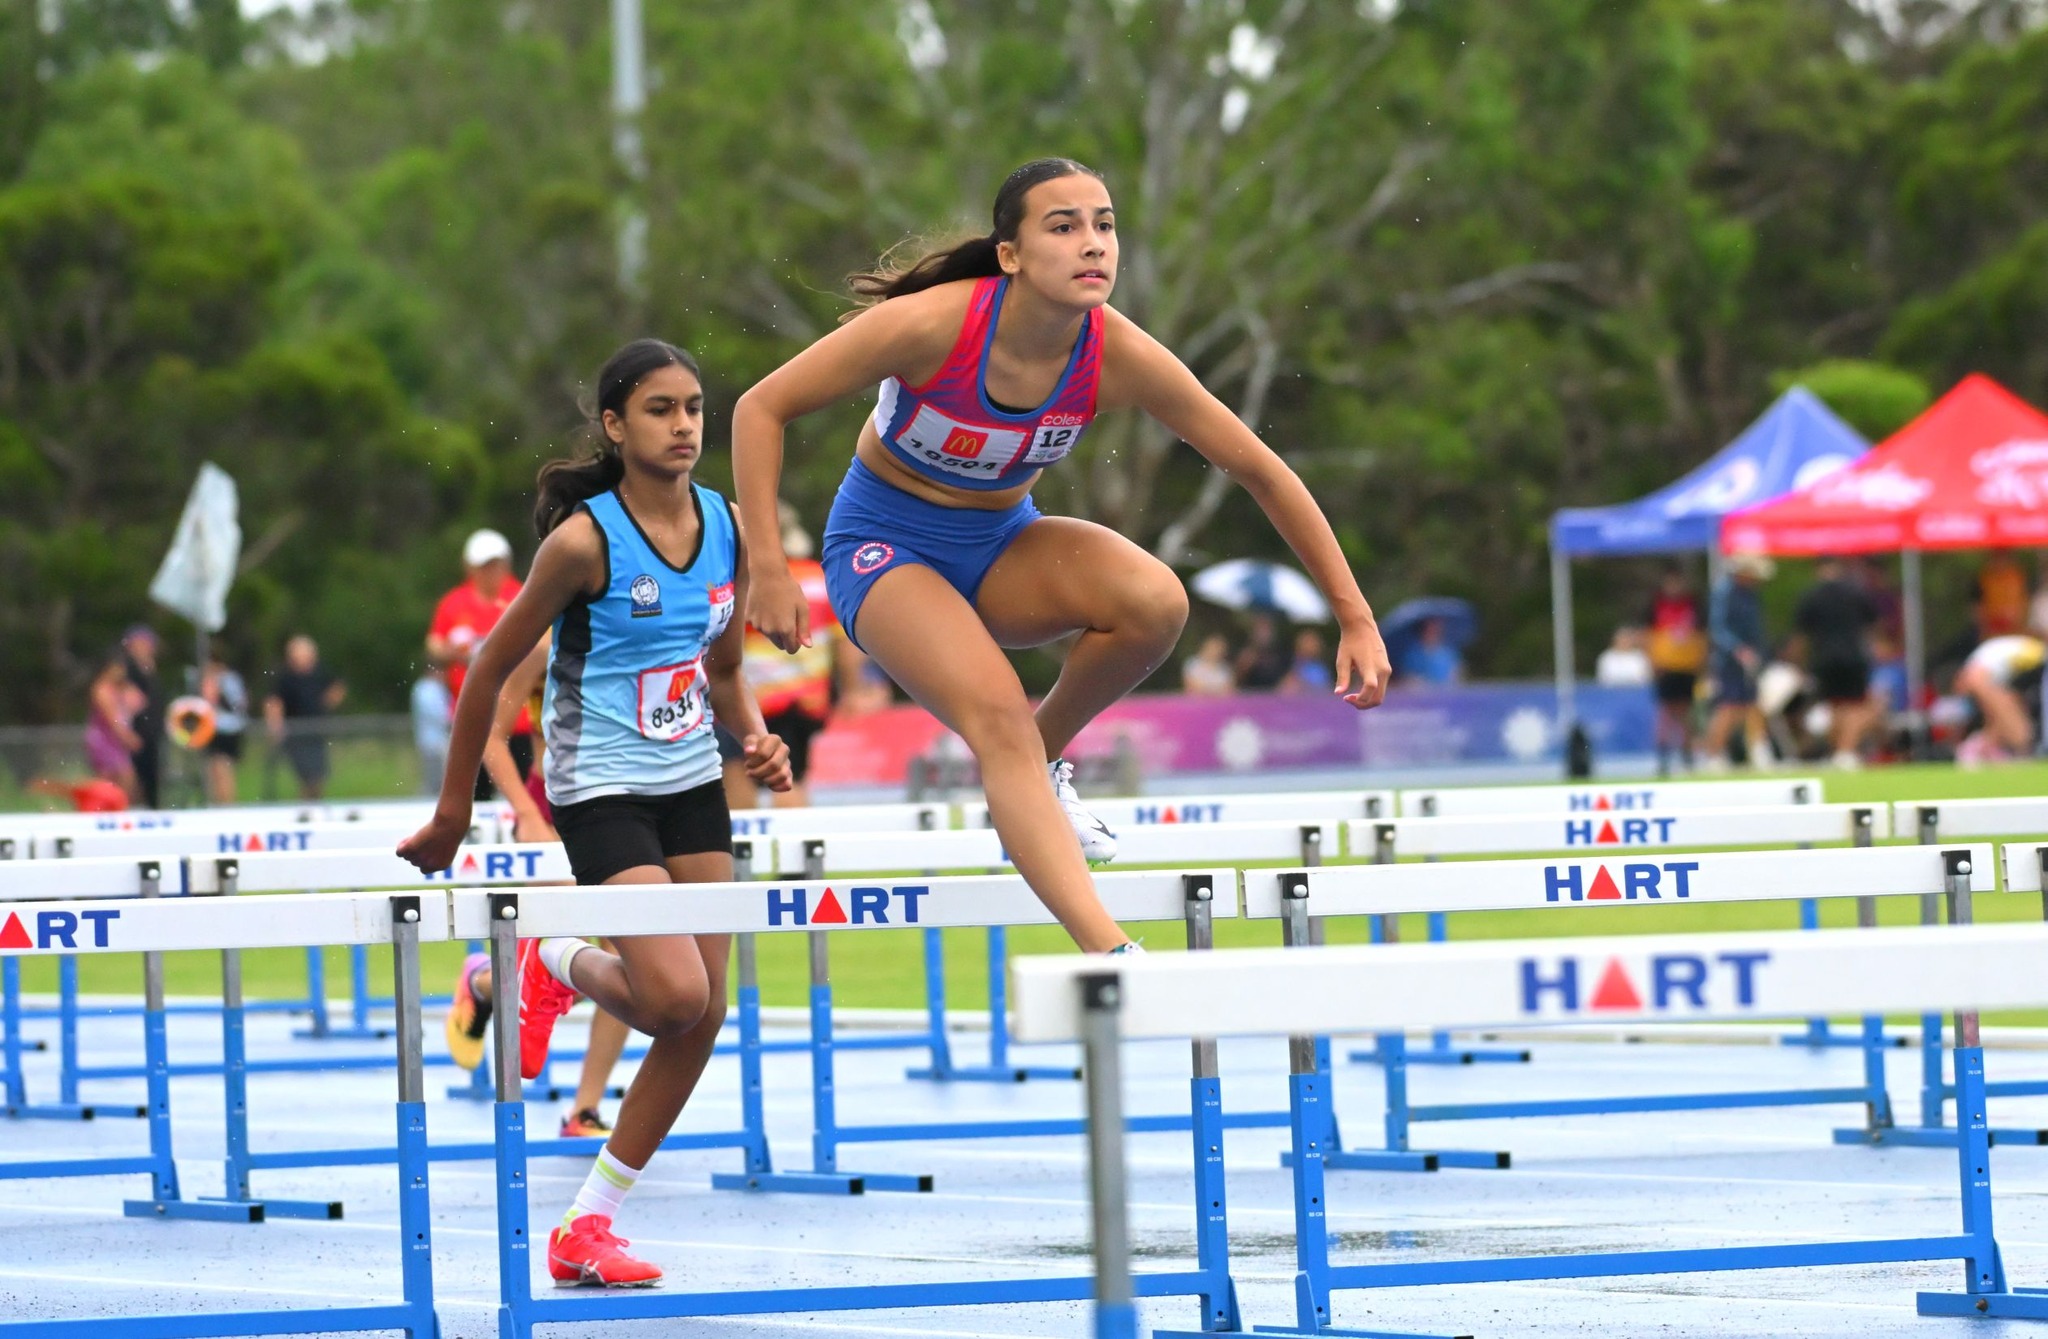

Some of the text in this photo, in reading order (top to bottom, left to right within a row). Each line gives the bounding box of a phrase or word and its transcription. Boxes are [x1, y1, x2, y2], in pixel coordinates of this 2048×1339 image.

[1042, 413, 1083, 425] coles
[1040, 429, 1072, 447] 12
[1135, 803, 1224, 824] HART
[1569, 791, 1655, 811] HART
[217, 830, 313, 853] HART
[1565, 817, 1676, 844] HART
[425, 849, 544, 880] ART
[1544, 862, 1699, 902] HART
[767, 886, 929, 926] HART
[1518, 949, 1772, 1014] HART
